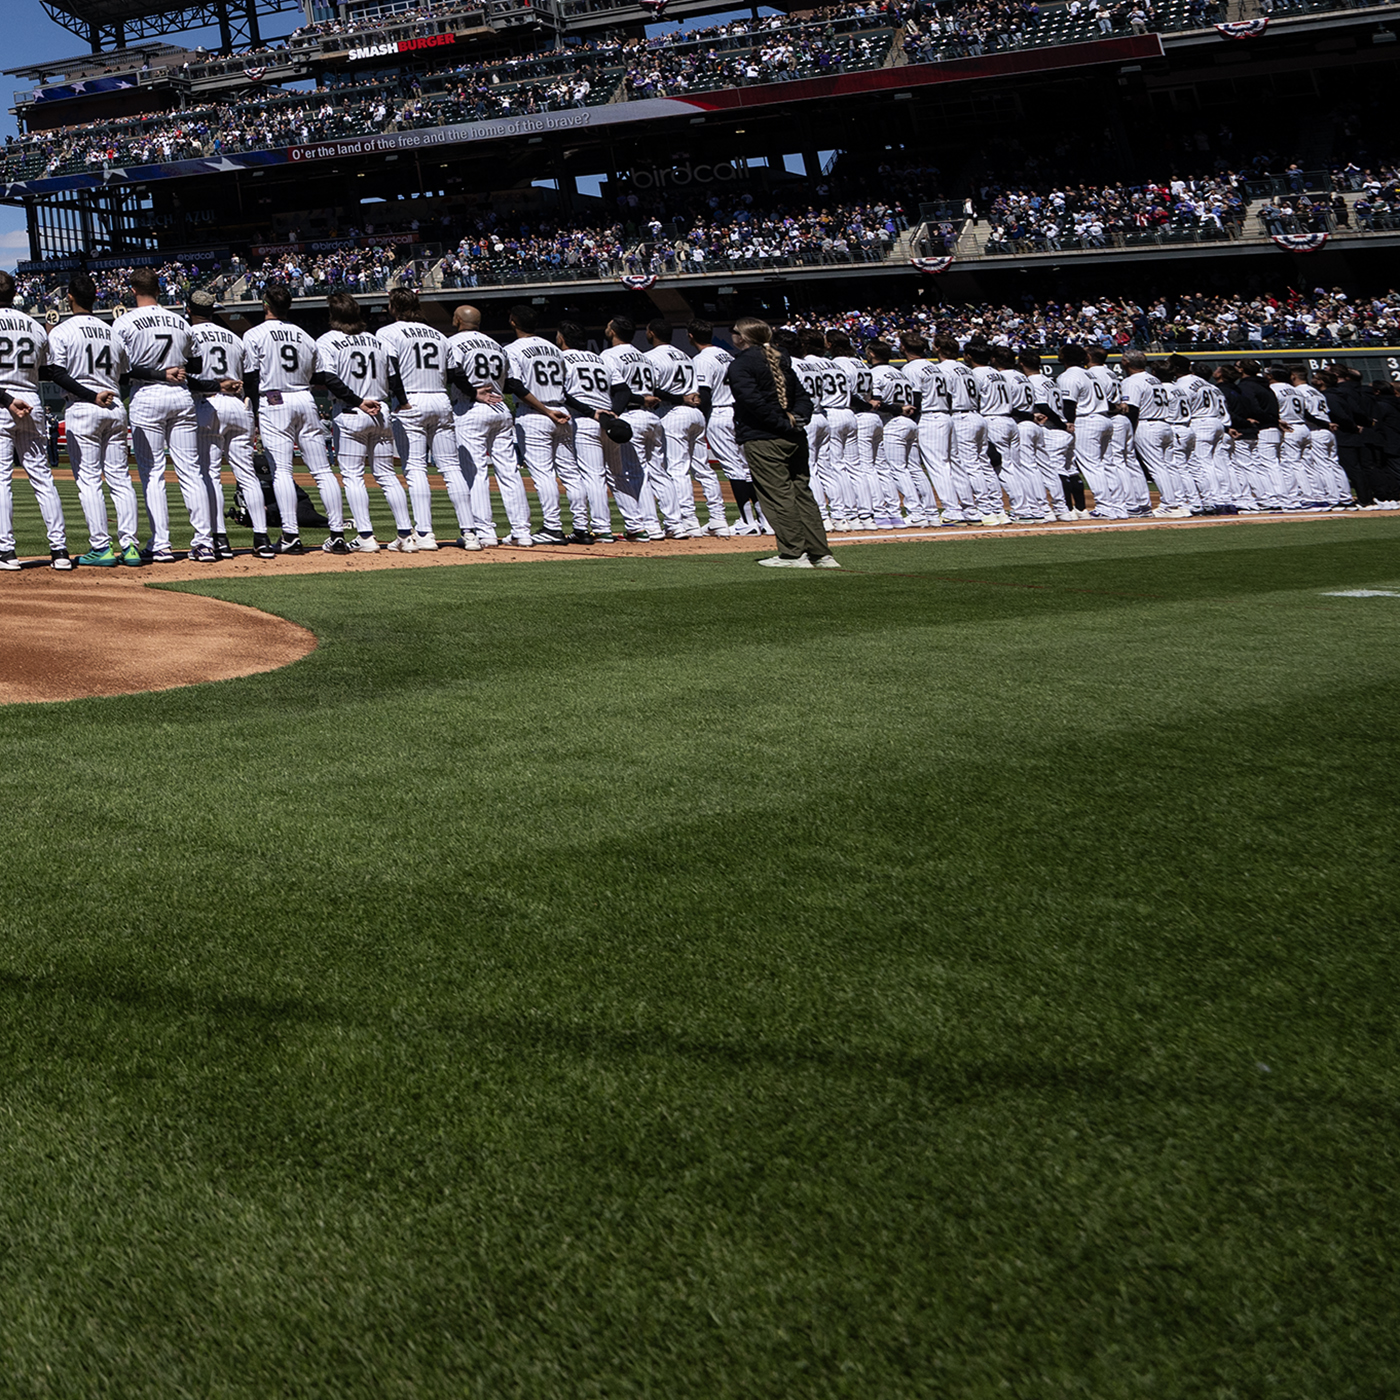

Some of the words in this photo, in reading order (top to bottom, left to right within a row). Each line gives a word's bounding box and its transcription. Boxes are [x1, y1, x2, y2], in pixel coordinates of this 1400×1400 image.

[292, 148, 316, 161] O'er
[317, 145, 336, 157] the
[337, 141, 361, 155] land
[364, 139, 377, 151] of
[377, 137, 396, 150] the
[398, 134, 420, 147] free
[423, 131, 446, 145] and
[448, 128, 468, 141] the
[470, 124, 506, 139] home
[508, 120, 522, 133] of
[523, 118, 543, 131] the
[546, 112, 591, 129] brave?
[630, 155, 750, 189] birdcall
[79, 325, 112, 341] TOVAR
[132, 315, 185, 332] RUMFIELD
[401, 328, 441, 341] KARROS
[155, 334, 173, 363] 7
[269, 330, 302, 344] DOYLE
[331, 334, 382, 350] McCARTHY
[86, 343, 112, 375] 14
[210, 346, 228, 375] 3
[281, 344, 299, 373] 9
[413, 342, 439, 370] 12
[522, 346, 560, 359] QUINTANA
[1387, 357, 1399, 369] 3
[351, 351, 376, 379] 31
[475, 353, 502, 380] 83
[533, 360, 562, 386] 62
[673, 365, 694, 388] 47
[577, 367, 608, 392] 56
[632, 366, 653, 391] 49
[823, 373, 847, 395] 32
[857, 372, 873, 393] 27
[935, 377, 947, 397] 21
[894, 384, 914, 405] 26
[1024, 386, 1033, 406] 6
